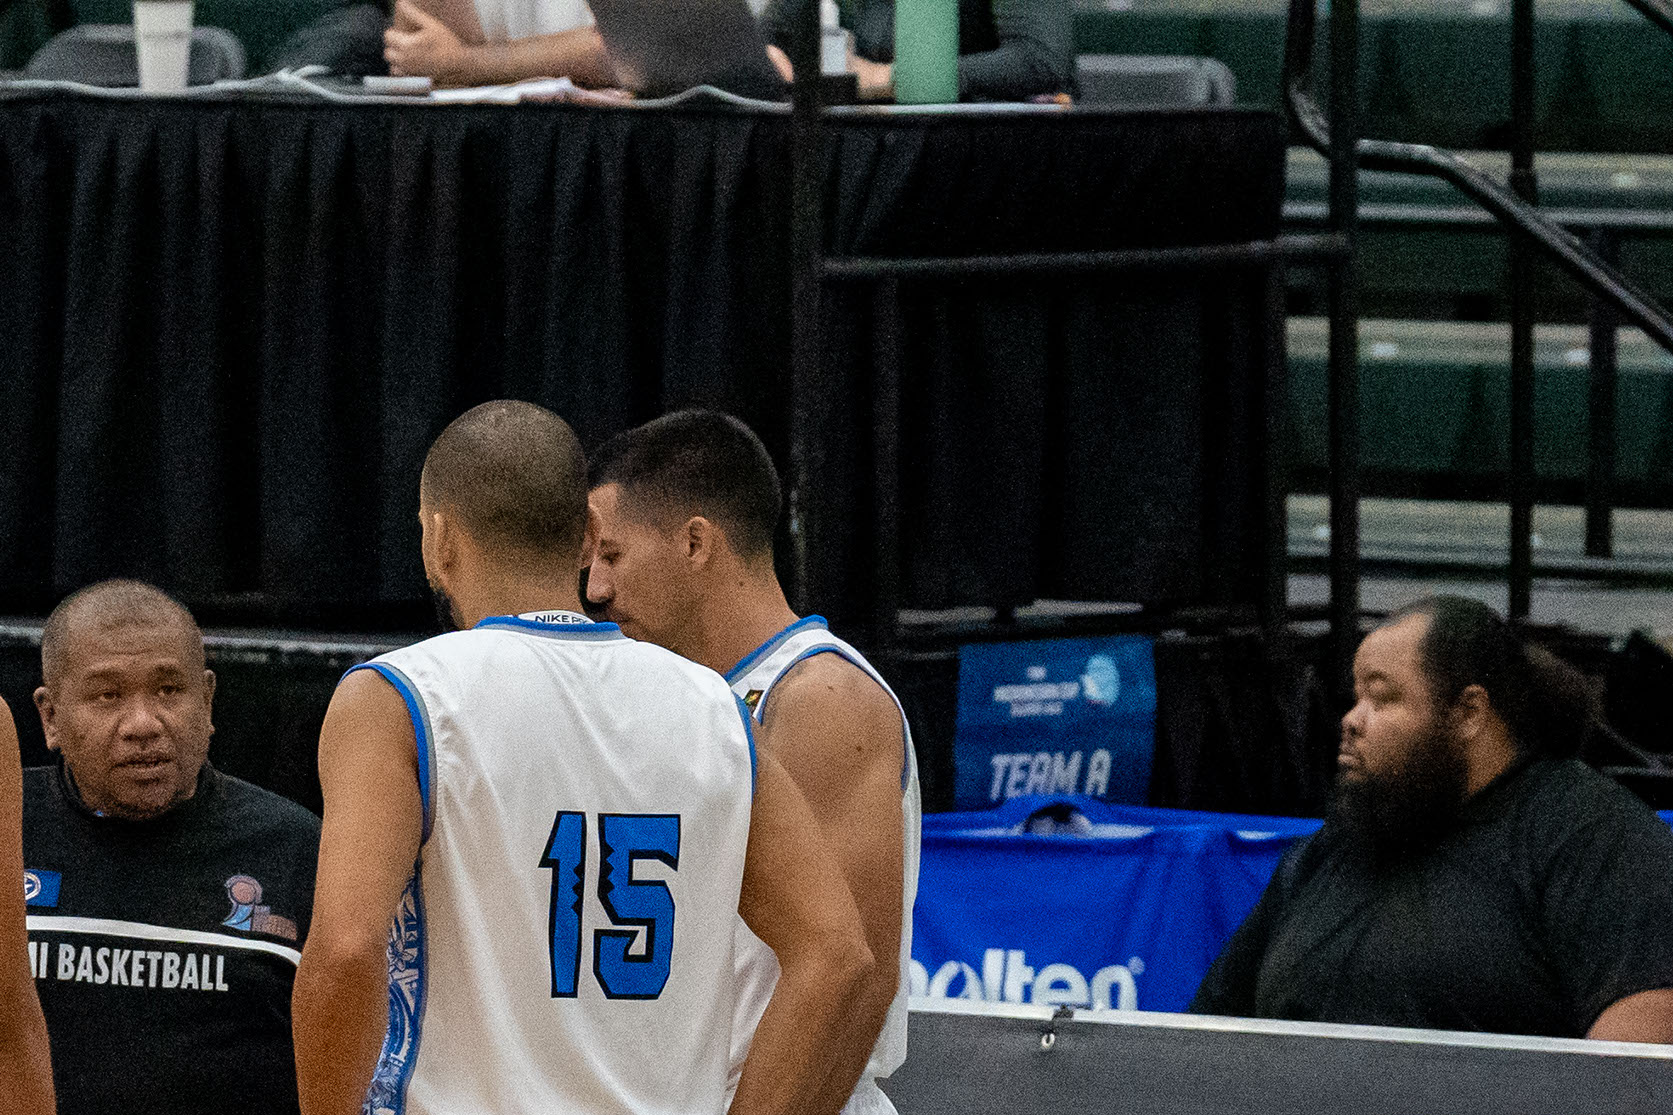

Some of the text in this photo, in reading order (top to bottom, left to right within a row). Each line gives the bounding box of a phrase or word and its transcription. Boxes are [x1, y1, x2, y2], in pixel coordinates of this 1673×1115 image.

[534, 614, 570, 623] NIKE
[990, 748, 1112, 801] TEAM A
[538, 810, 681, 1000] 15
[57, 943, 228, 992] BASKETBALL
[910, 948, 1138, 1011] olten
